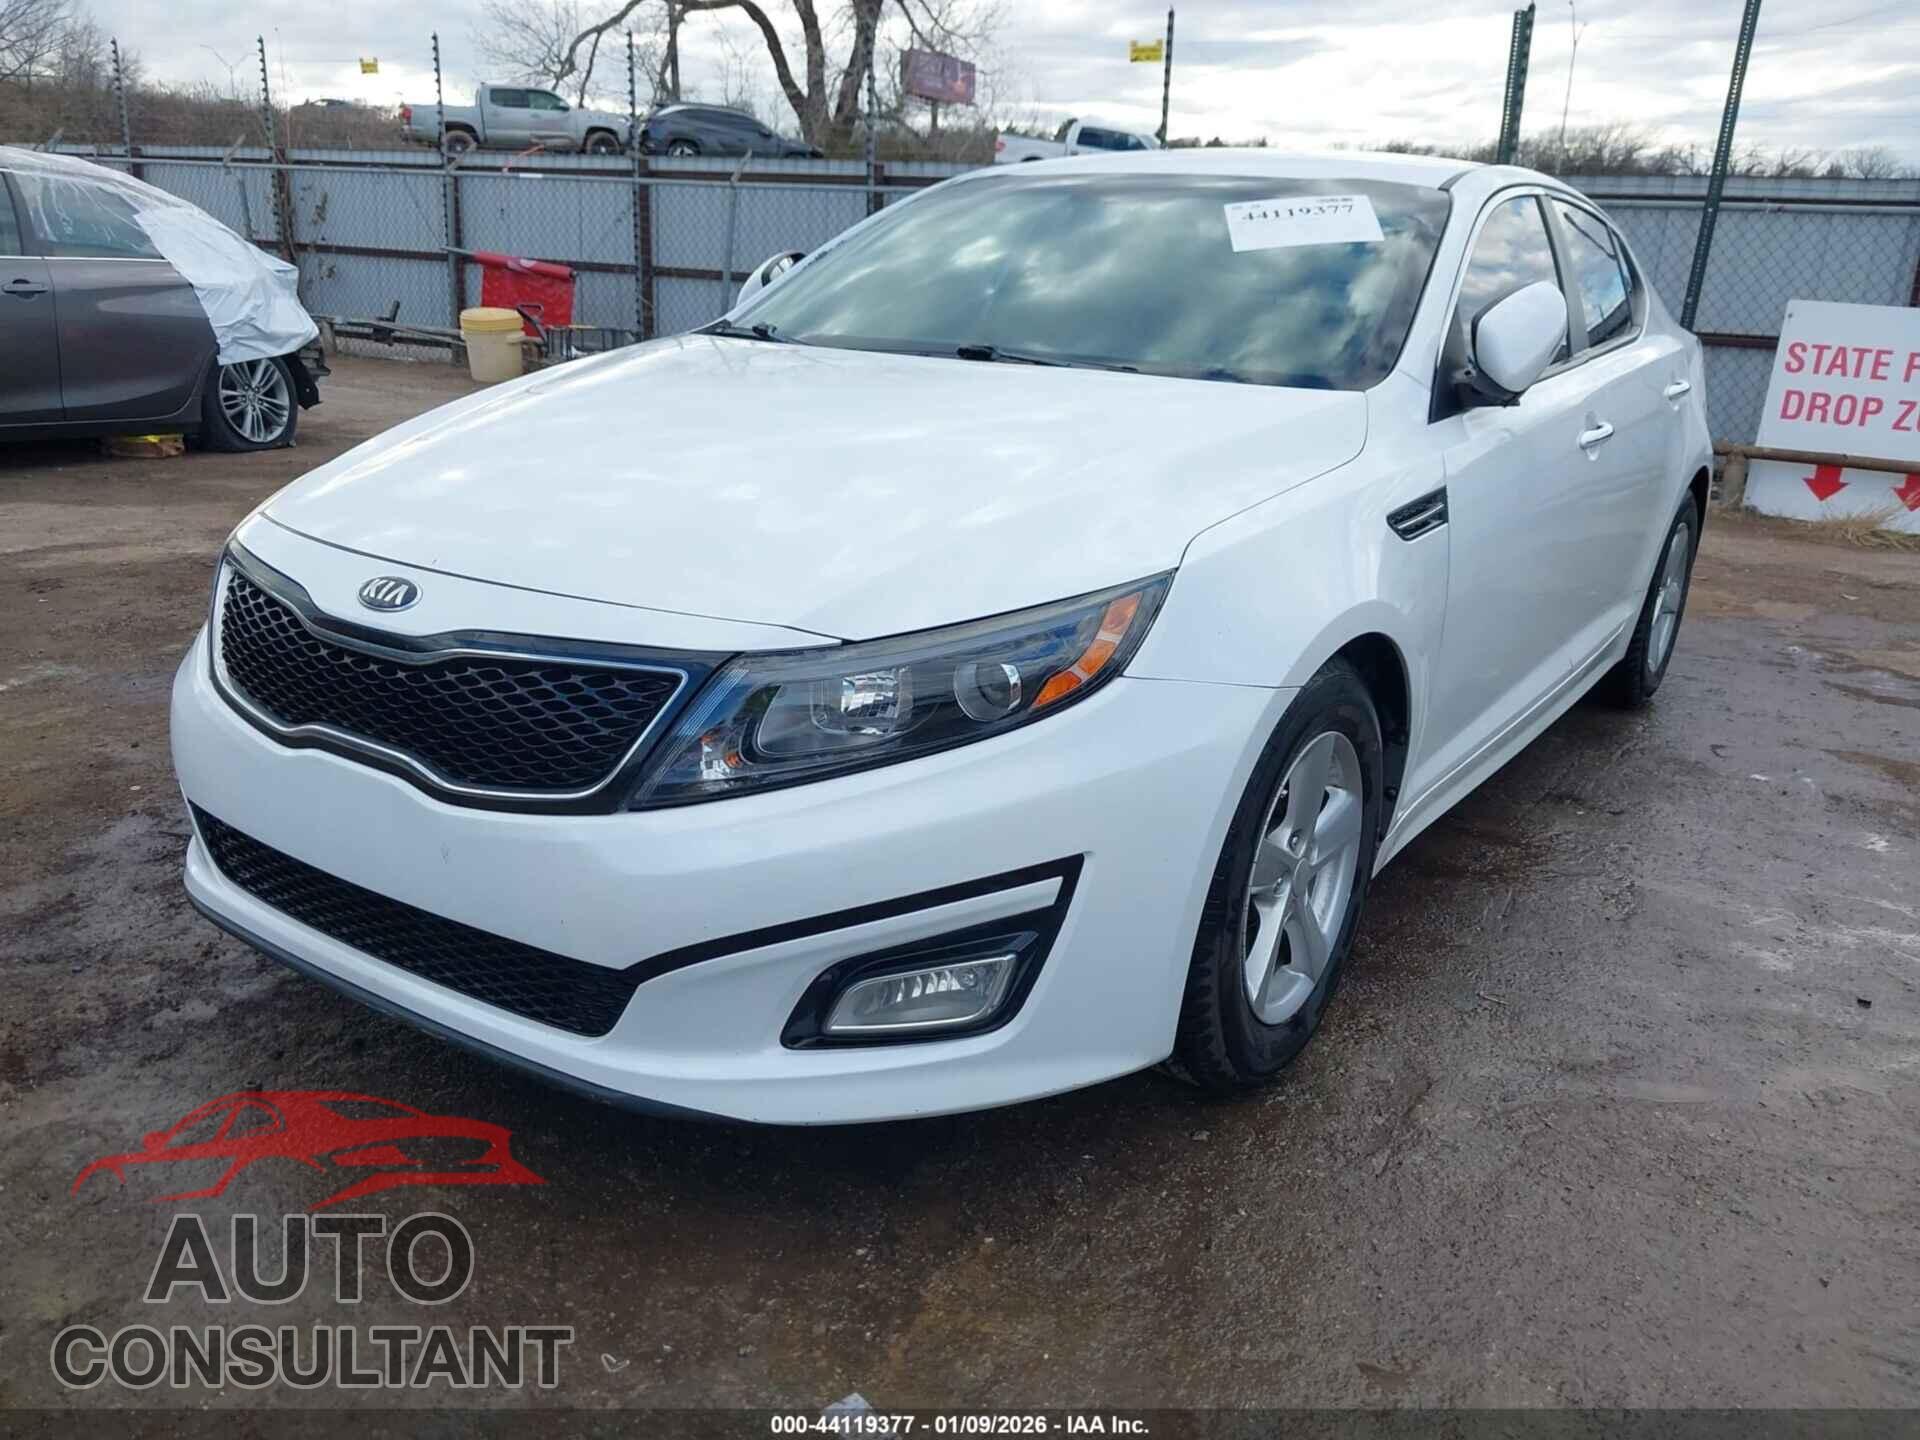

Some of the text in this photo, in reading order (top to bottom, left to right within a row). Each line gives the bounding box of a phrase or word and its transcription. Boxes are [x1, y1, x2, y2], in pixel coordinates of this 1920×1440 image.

[1784, 341, 1894, 381] STATE
[1780, 389, 1920, 433] DROP Z
[362, 578, 409, 606] KIA
